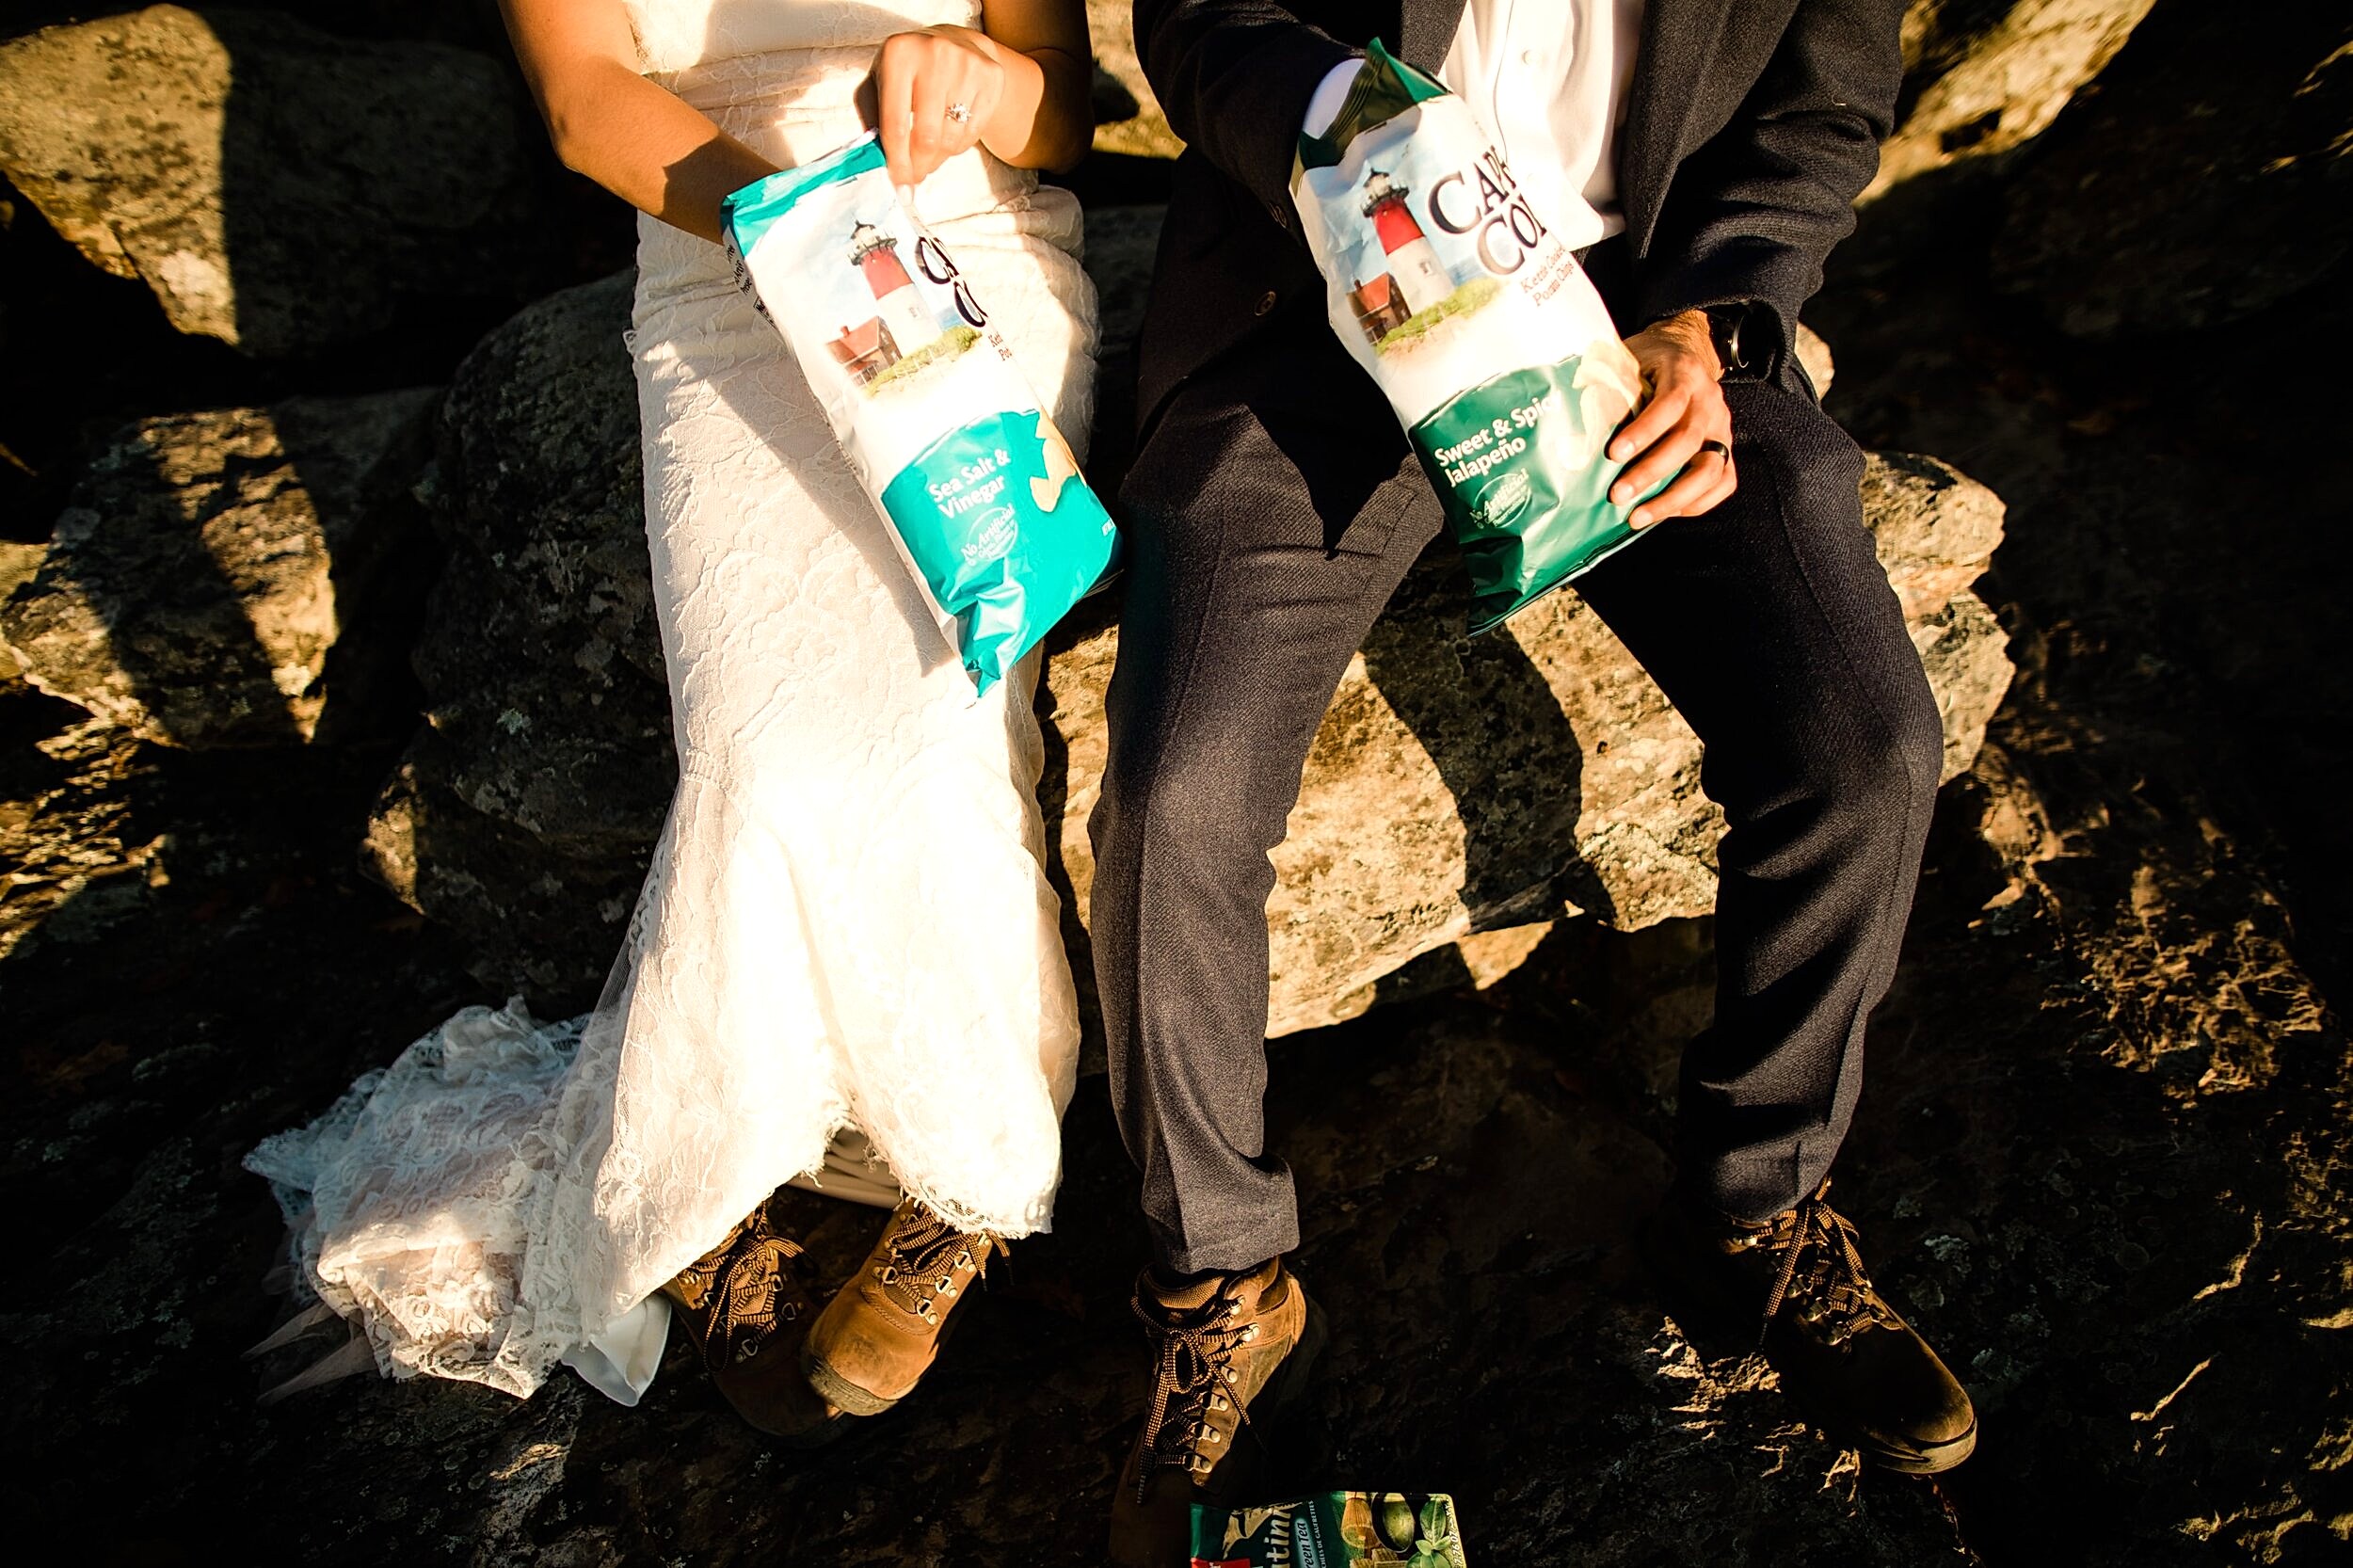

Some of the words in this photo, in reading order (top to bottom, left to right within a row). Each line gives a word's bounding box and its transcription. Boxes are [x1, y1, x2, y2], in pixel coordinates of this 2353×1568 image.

[1433, 428, 1492, 469] Sweet
[1491, 417, 1514, 440] &
[1445, 434, 1528, 488] Jalapeño
[928, 475, 964, 503] Sea
[963, 456, 998, 484] Salt
[994, 448, 1012, 467] &
[937, 473, 1007, 519] Vinegar
[1296, 1522, 1309, 1542] Tea
